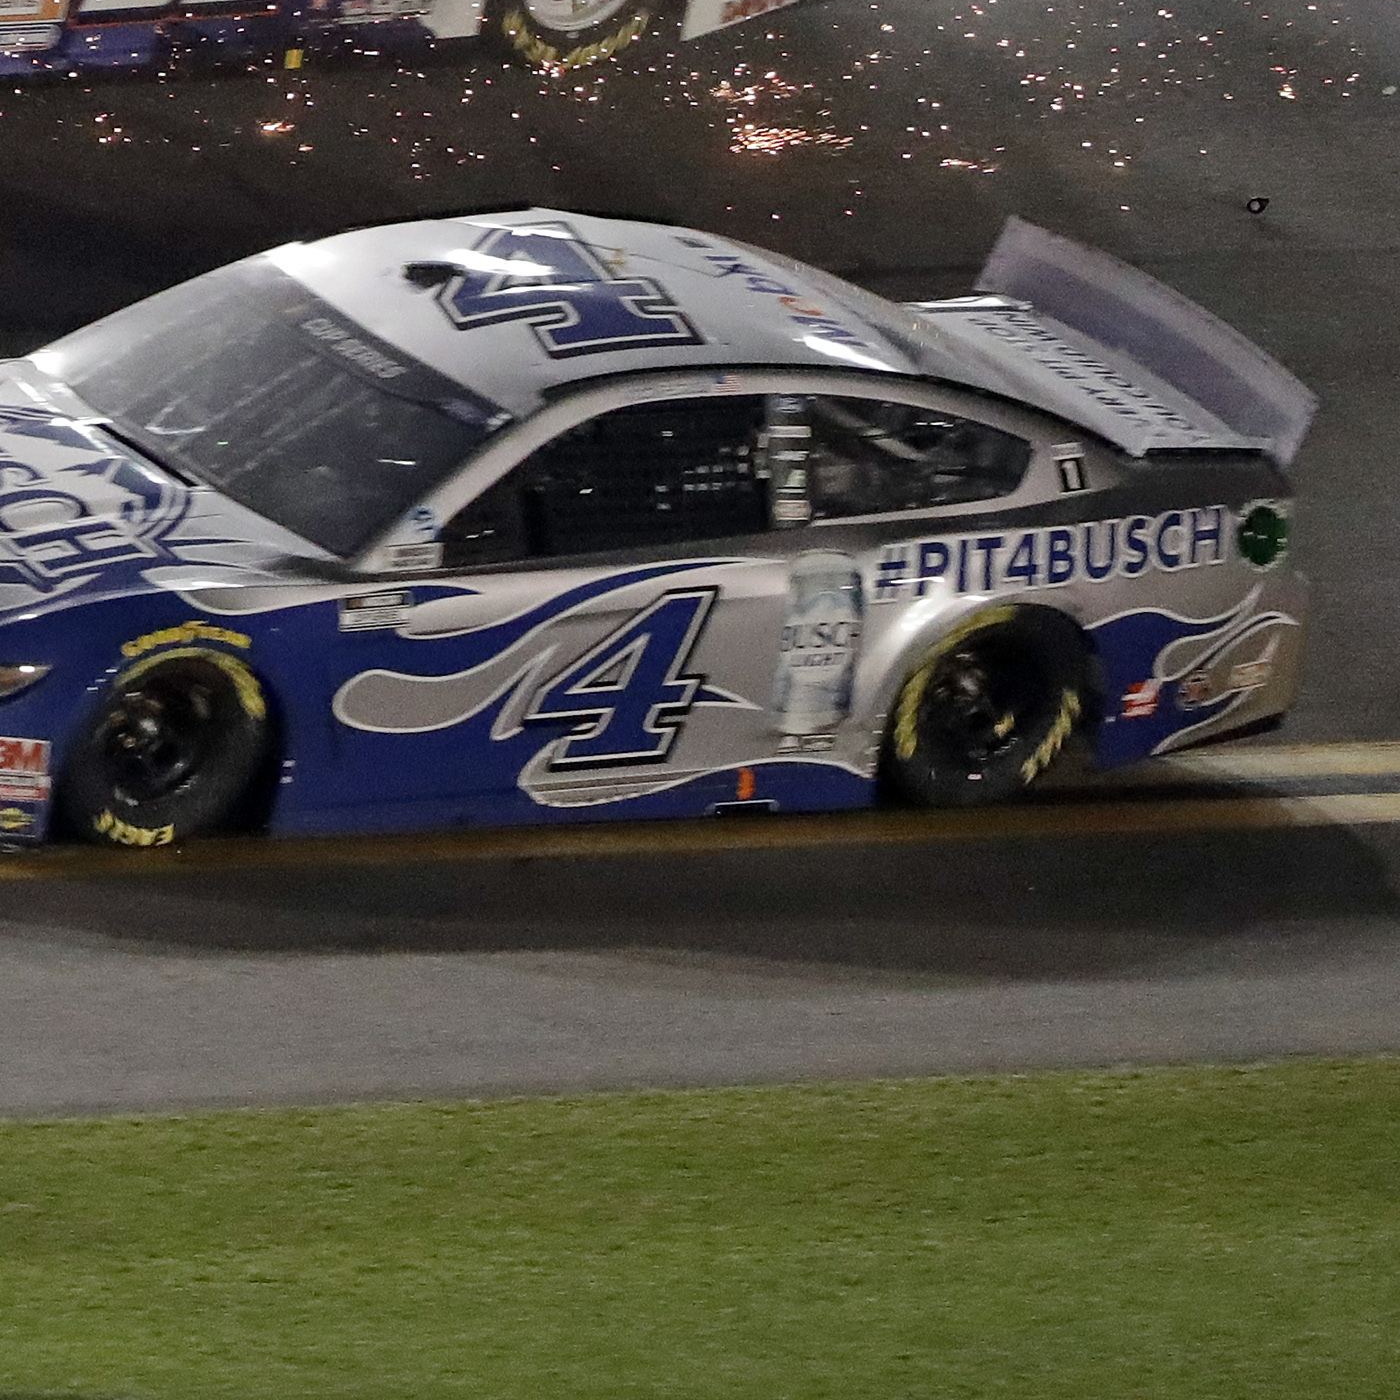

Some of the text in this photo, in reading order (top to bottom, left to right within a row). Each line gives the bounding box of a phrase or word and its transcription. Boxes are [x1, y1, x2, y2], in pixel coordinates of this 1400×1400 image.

[434, 220, 704, 360] 4
[875, 506, 1222, 598] #PIT4BUSCH
[523, 584, 721, 773] 4
